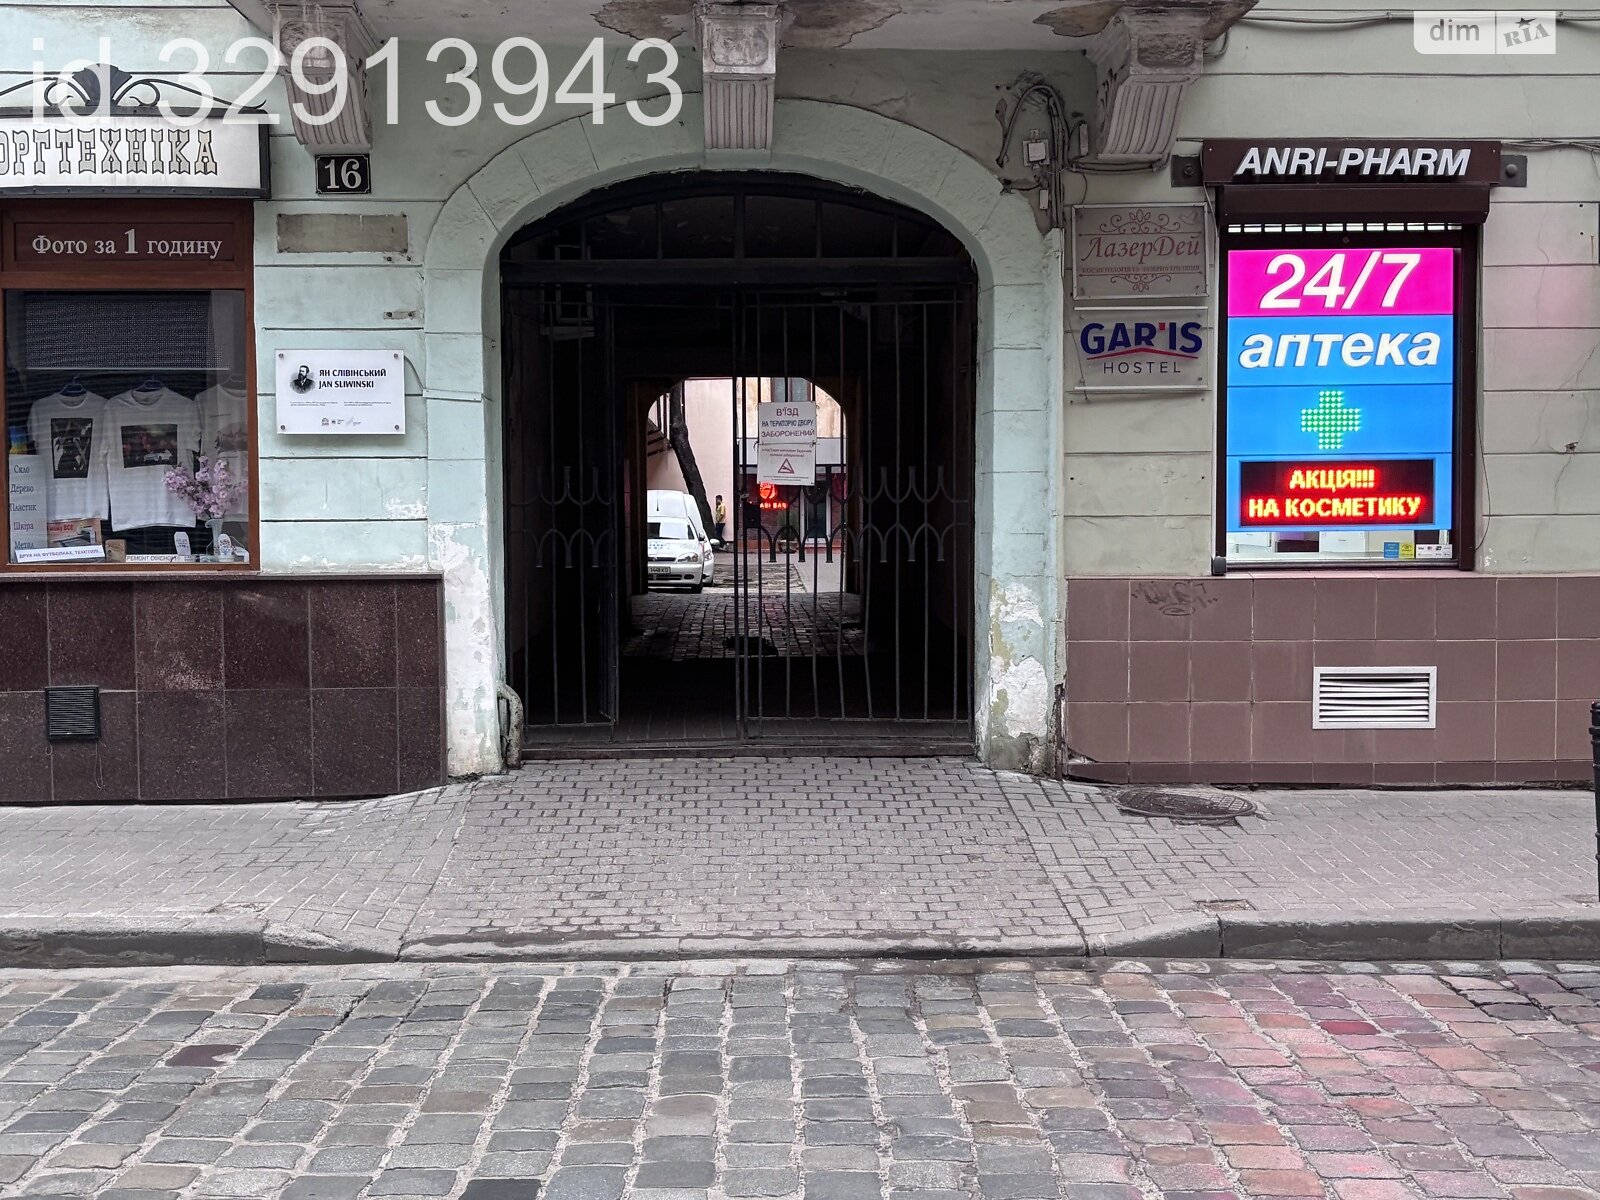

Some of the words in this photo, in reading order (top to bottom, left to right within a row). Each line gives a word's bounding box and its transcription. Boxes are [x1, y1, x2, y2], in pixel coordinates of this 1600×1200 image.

[1234, 146, 1471, 176] ANRI-PHARM
[324, 158, 362, 190] 16
[32, 235, 88, 254] Фото
[94, 240, 117, 254] за
[124, 228, 138, 254] 1
[147, 240, 222, 259] годину
[1081, 235, 1200, 264] ЛазерДей
[1258, 250, 1422, 310] 24/7
[1080, 321, 1202, 355] GAR'IS
[1238, 331, 1441, 368] аптека
[319, 369, 331, 377] ЯН
[332, 368, 387, 377] СЛІВІНСЬКИЙ
[1103, 361, 1181, 374] HOSTEL
[318, 380, 333, 389] JAN
[334, 380, 374, 388] SLIWINSKI
[761, 420, 769, 428] НА
[797, 419, 814, 427] ДВОРУ
[761, 428, 815, 438] ЗАБОРОНЕНИЙ
[10, 484, 34, 494] Дерево
[1289, 468, 1375, 492] АКЦІЯ!!!
[1248, 498, 1280, 518] НА
[1285, 496, 1422, 518] КОСМЕТИКУ
